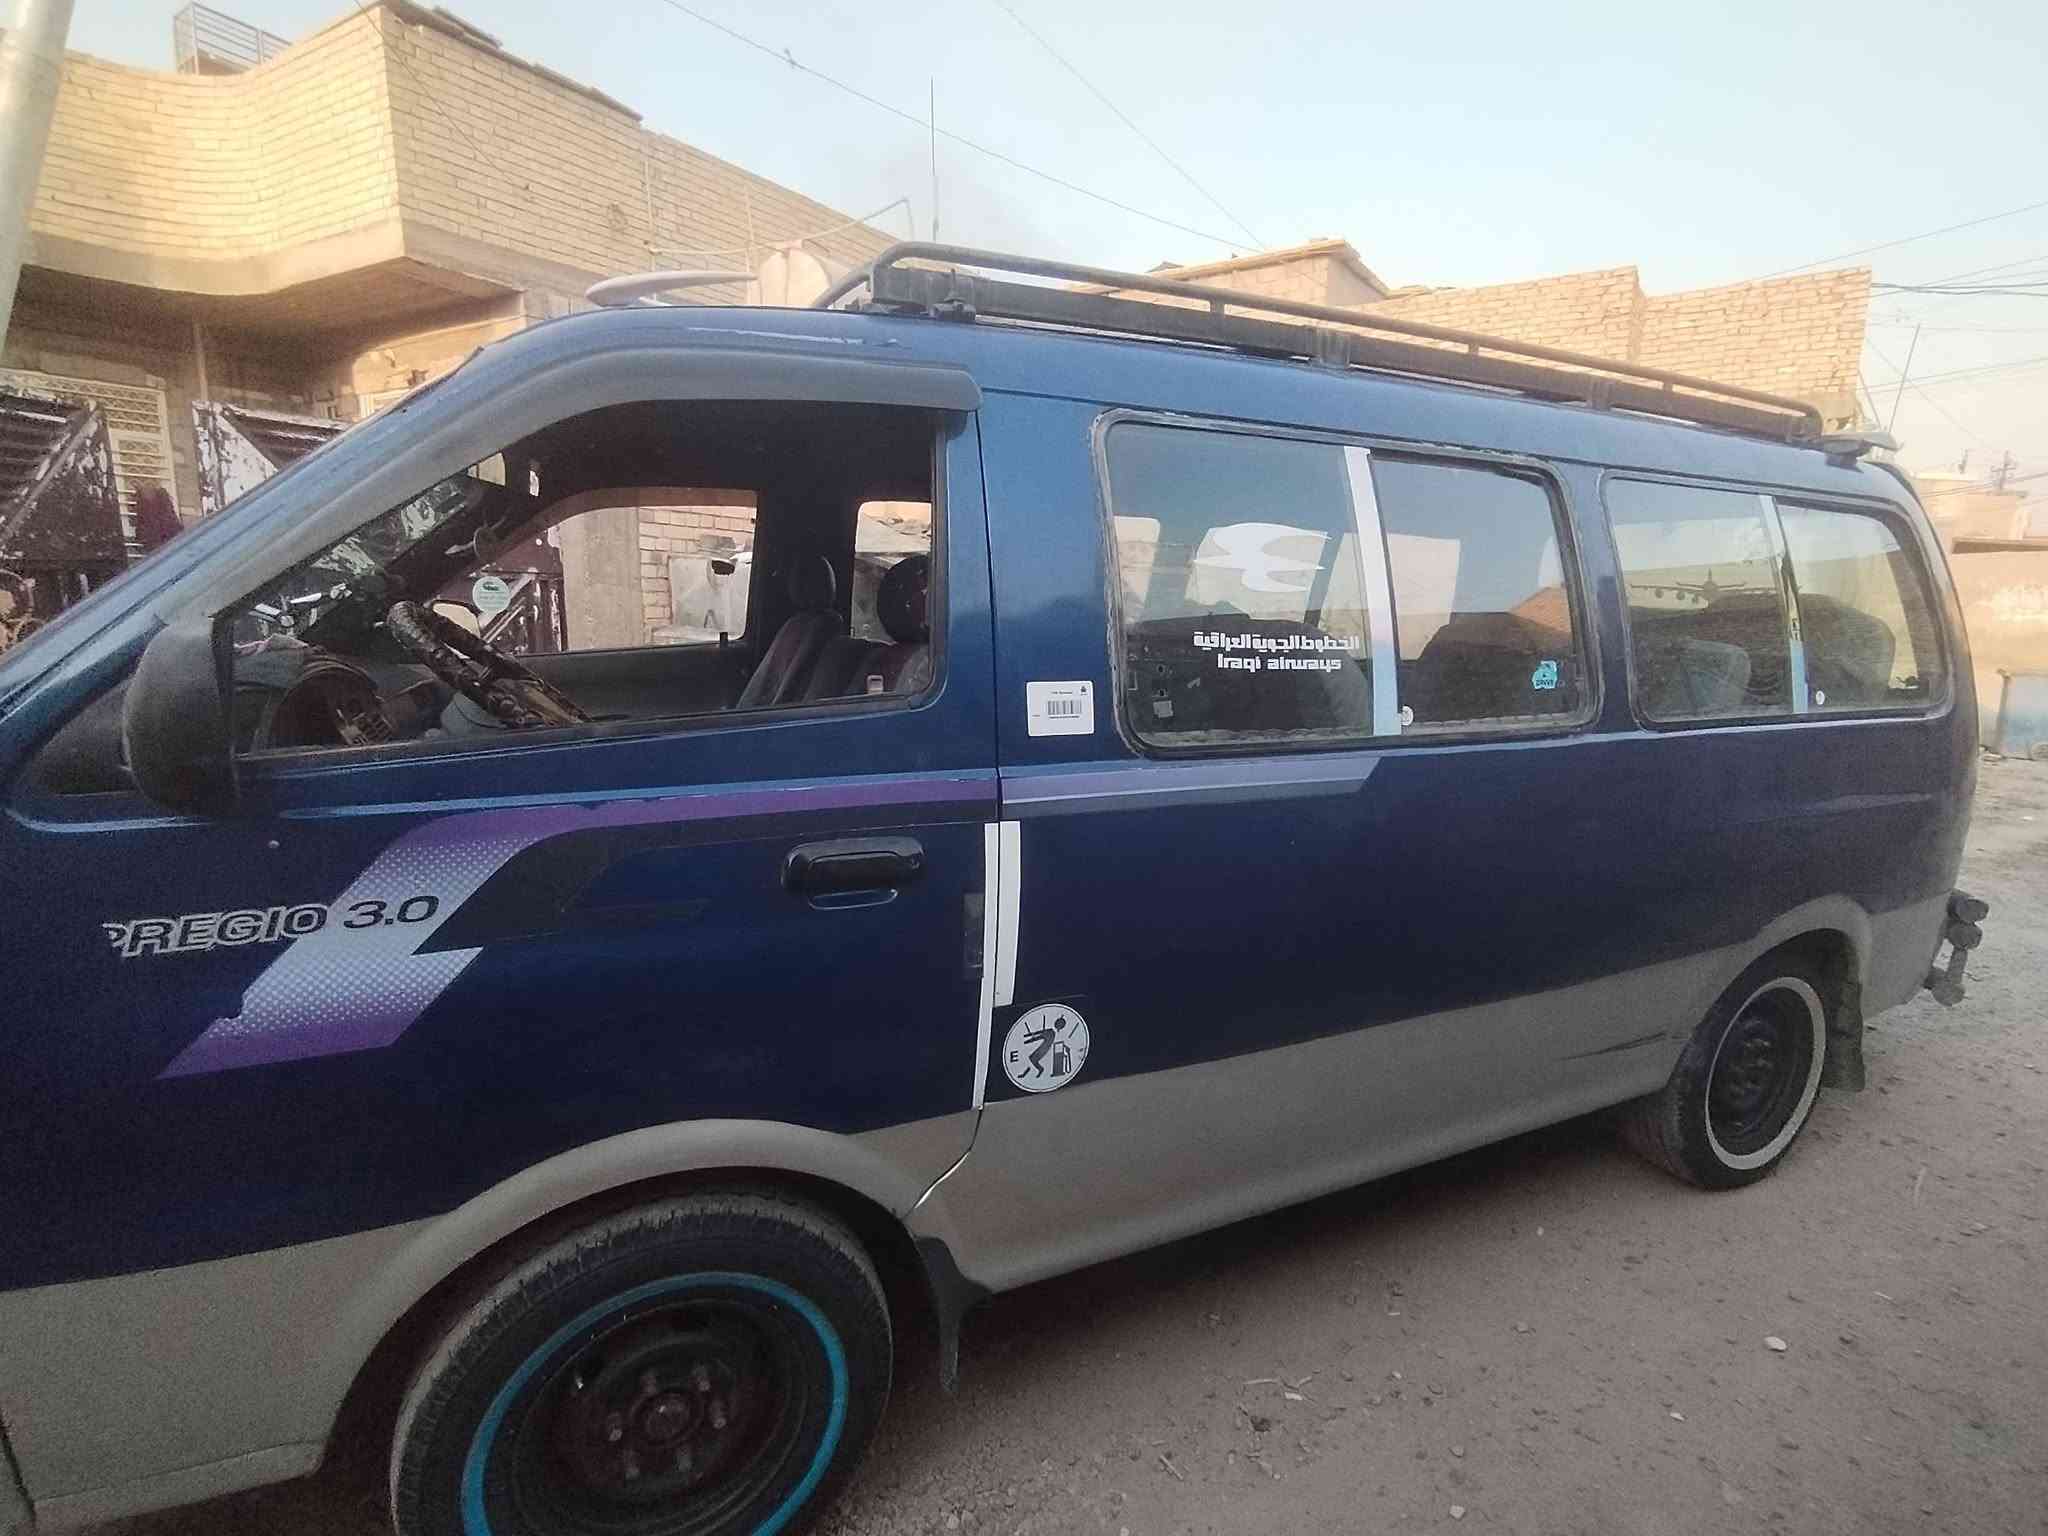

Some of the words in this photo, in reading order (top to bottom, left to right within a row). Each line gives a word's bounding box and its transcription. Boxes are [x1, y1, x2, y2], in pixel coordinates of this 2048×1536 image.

[1193, 631, 1251, 651] العراقية
[1252, 634, 1300, 653] الجوية
[1300, 635, 1360, 653] الخطوط
[1217, 653, 1262, 673] Iraqi
[1267, 656, 1342, 673] airways
[343, 895, 440, 929] 3.0
[1010, 1050, 1019, 1063] E
